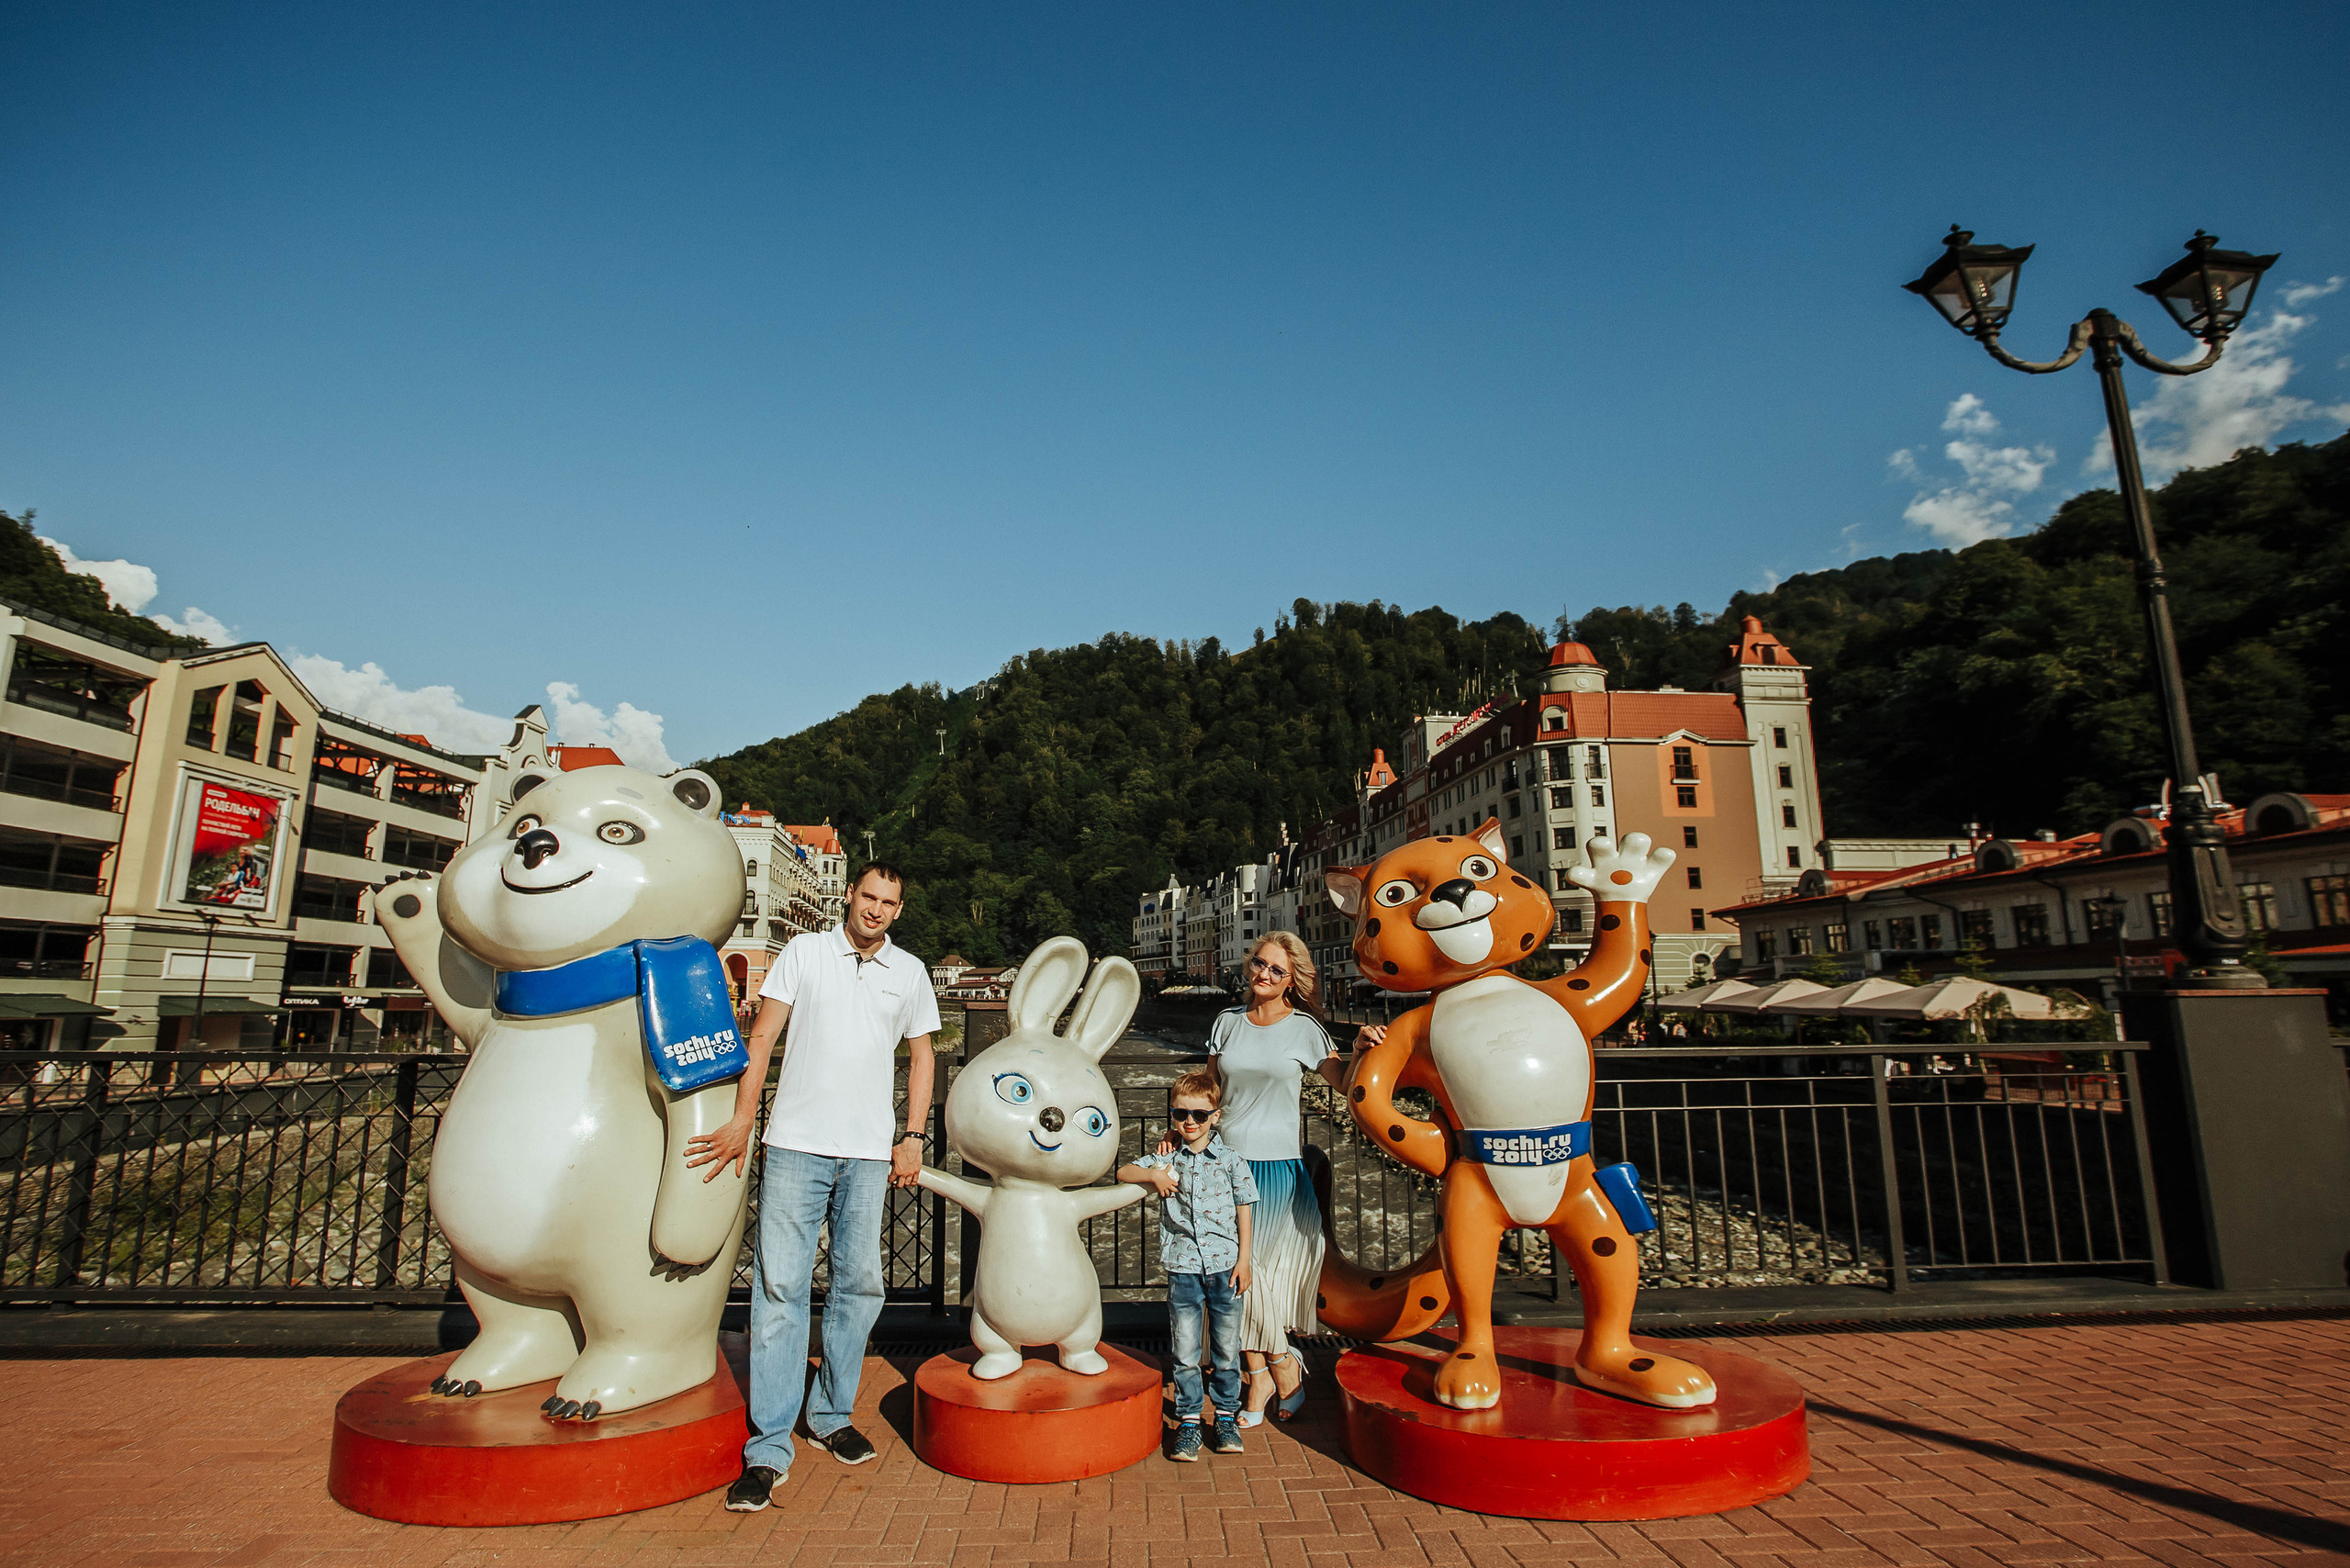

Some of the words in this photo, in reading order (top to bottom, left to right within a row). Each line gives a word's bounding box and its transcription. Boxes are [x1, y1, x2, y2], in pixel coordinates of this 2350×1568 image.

[663, 1029, 734, 1058] sochi.ru
[676, 1047, 716, 1067] 2014
[1483, 1133, 1572, 1150] sochi.ru
[1492, 1148, 1544, 1166] 2014
